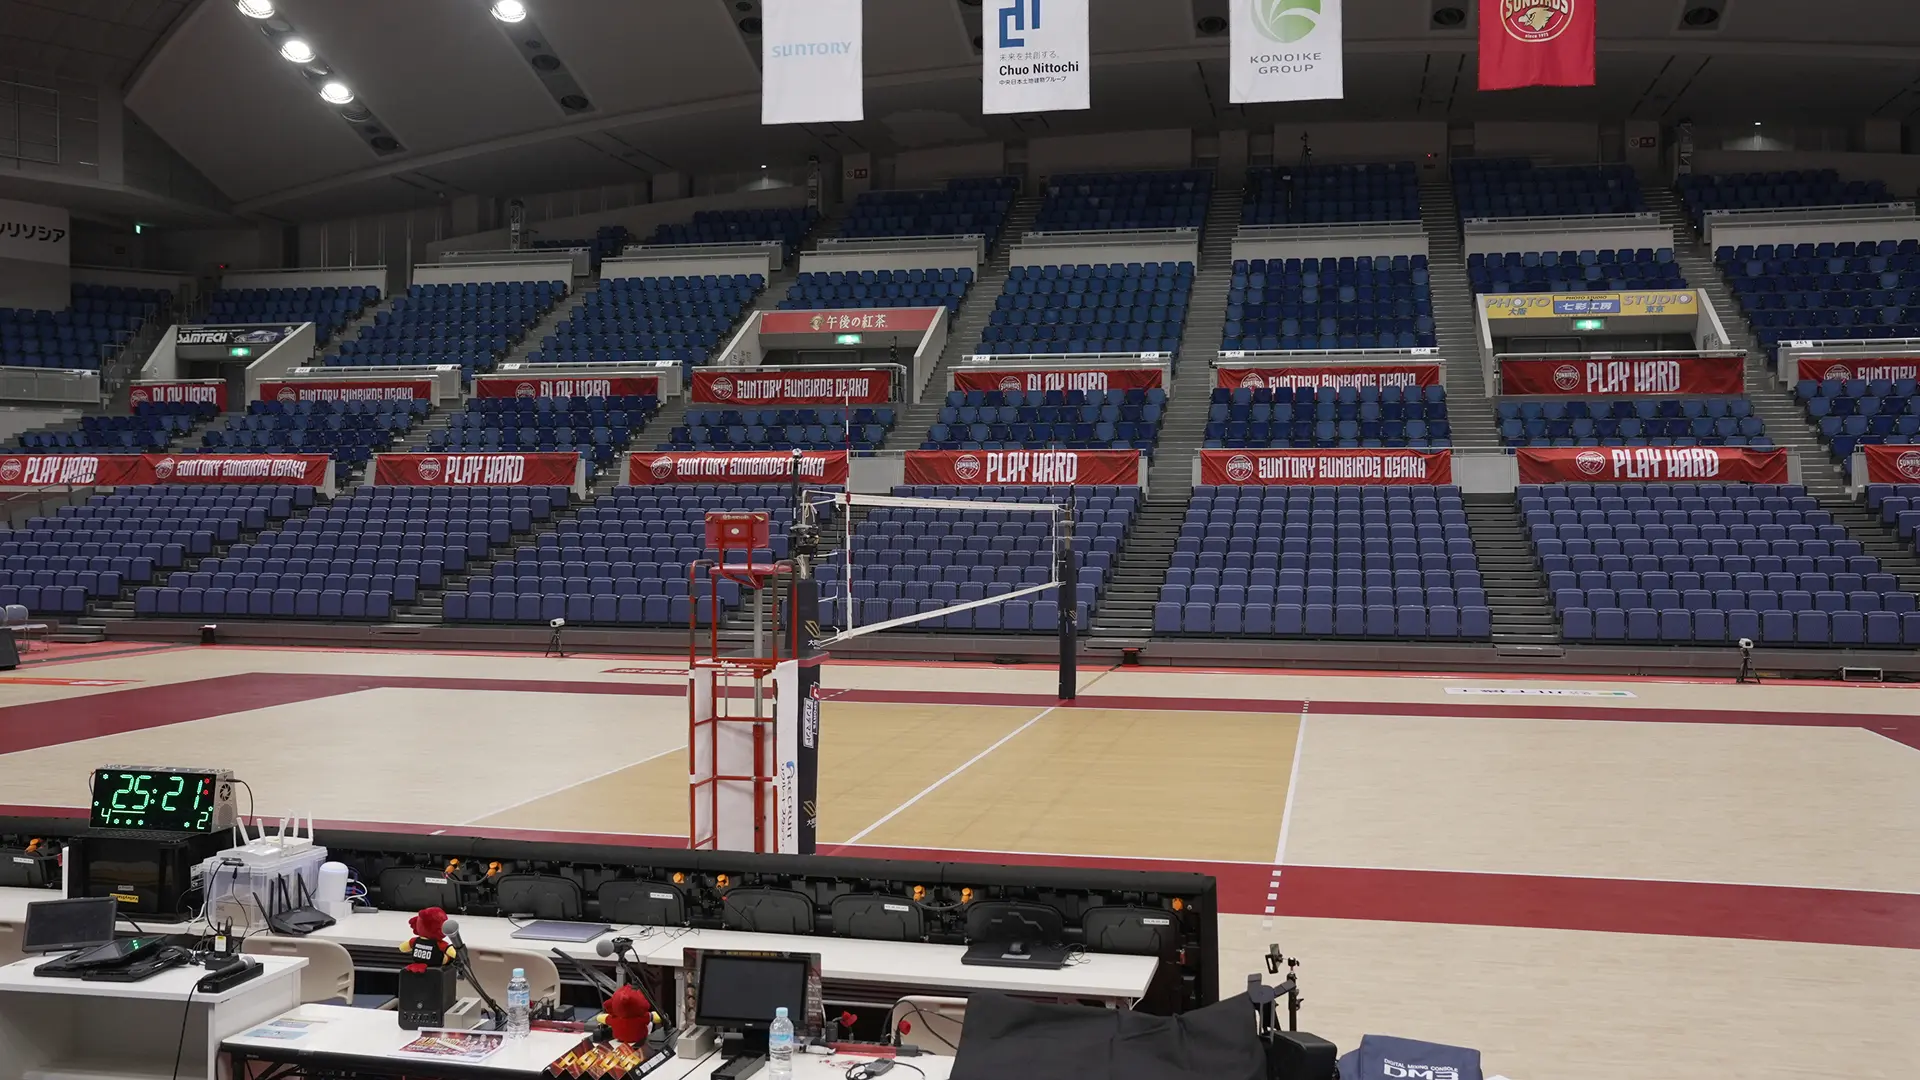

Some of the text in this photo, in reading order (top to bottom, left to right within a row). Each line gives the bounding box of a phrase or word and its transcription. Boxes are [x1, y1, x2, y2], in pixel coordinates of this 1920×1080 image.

[1250, 52, 1322, 63] KONOIKE
[999, 61, 1079, 76] Chuo Nittochi
[1258, 64, 1314, 74] GROUP
[1486, 297, 1551, 308] PHOTO
[1624, 294, 1692, 305] STUDIO
[826, 314, 886, 329] 午後の紅茶
[177, 333, 228, 343] SAMTECH
[1586, 361, 1680, 392] PLAY HARD
[737, 378, 869, 398] SUNTORY SUNBIRDS OSAKA
[24, 457, 99, 483] PLAY HARD
[176, 460, 223, 477] SUNTORY
[222, 459, 271, 477] SUNBIRDS
[271, 459, 307, 479] OSAKA
[444, 456, 524, 483] PLAY HARD
[677, 457, 726, 475] SUNTORY
[730, 457, 784, 476] SUNBIRDS
[986, 453, 1077, 482] PLAY HARD
[1258, 457, 1426, 478] SUNTORY SUNBIRDS OSAKA
[1611, 449, 1718, 478] PLAY HARD
[101, 808, 111, 824] 4
[197, 812, 209, 829] 2
[413, 949, 432, 960] 2020
[1383, 1058, 1405, 1068] DIGITAL
[1383, 1063, 1459, 1080] DM3
